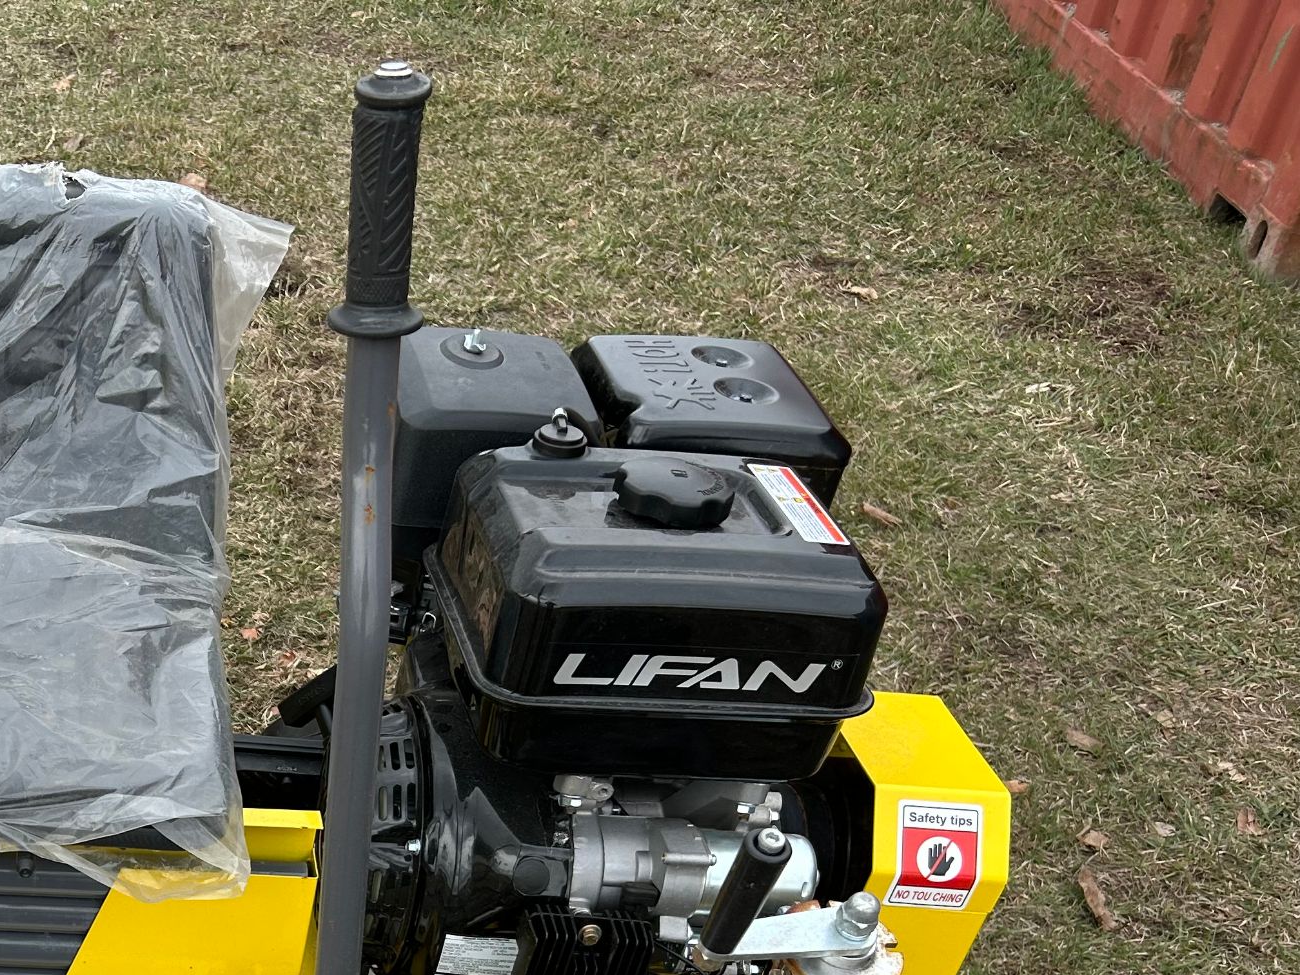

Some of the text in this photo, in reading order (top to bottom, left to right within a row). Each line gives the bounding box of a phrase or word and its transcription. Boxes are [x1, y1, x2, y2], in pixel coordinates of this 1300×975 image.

[552, 652, 828, 694] LIFAN
[909, 812, 973, 827] Safety tips
[895, 890, 910, 900] NO
